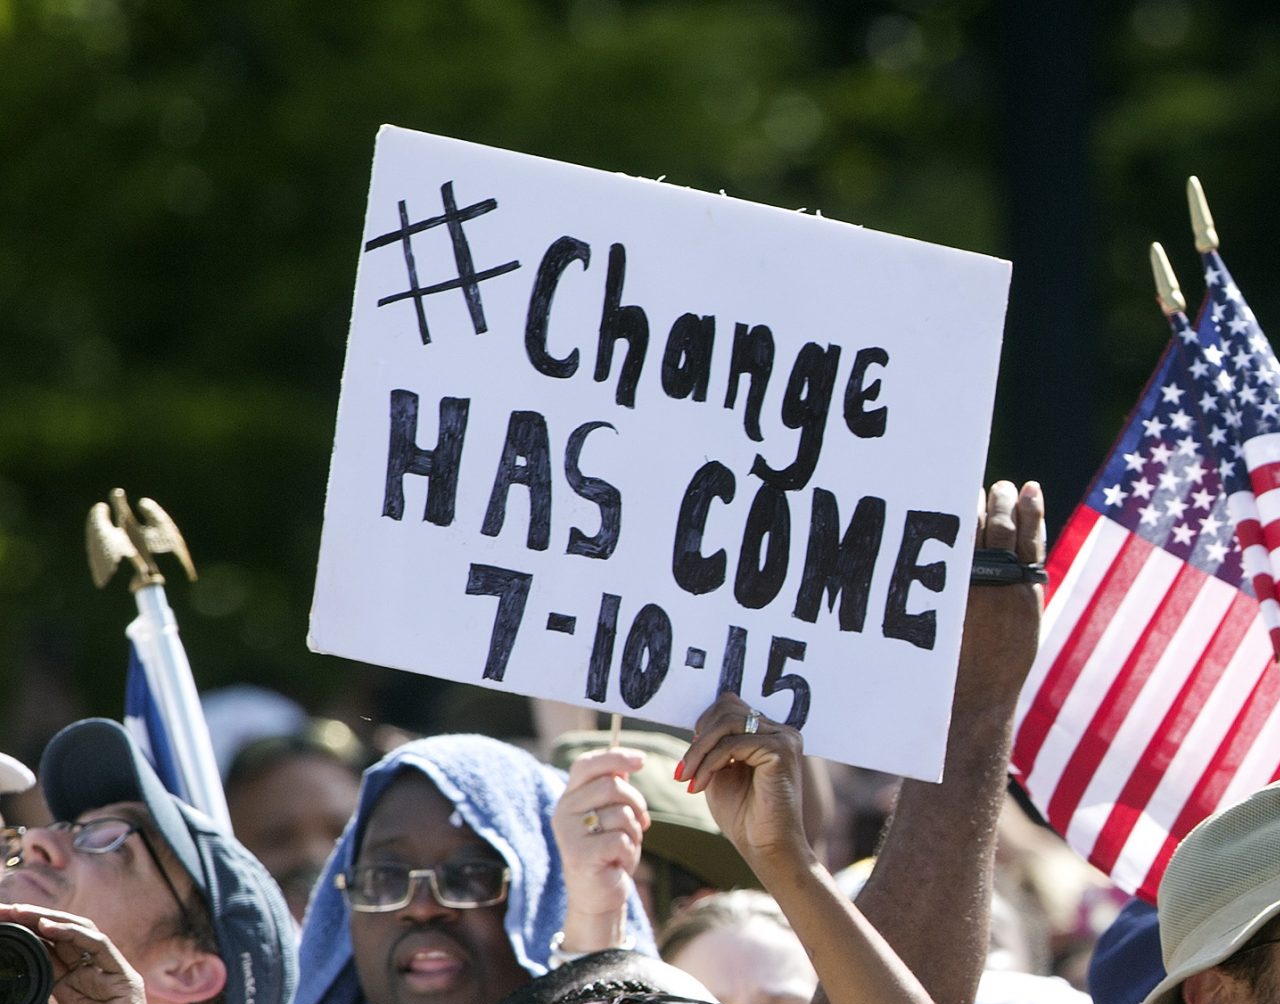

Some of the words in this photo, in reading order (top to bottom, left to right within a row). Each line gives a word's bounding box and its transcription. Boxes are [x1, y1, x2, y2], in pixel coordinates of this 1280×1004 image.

[382, 389, 622, 560] HAS
[672, 456, 960, 651] COME
[465, 563, 811, 733] 7-10-15
